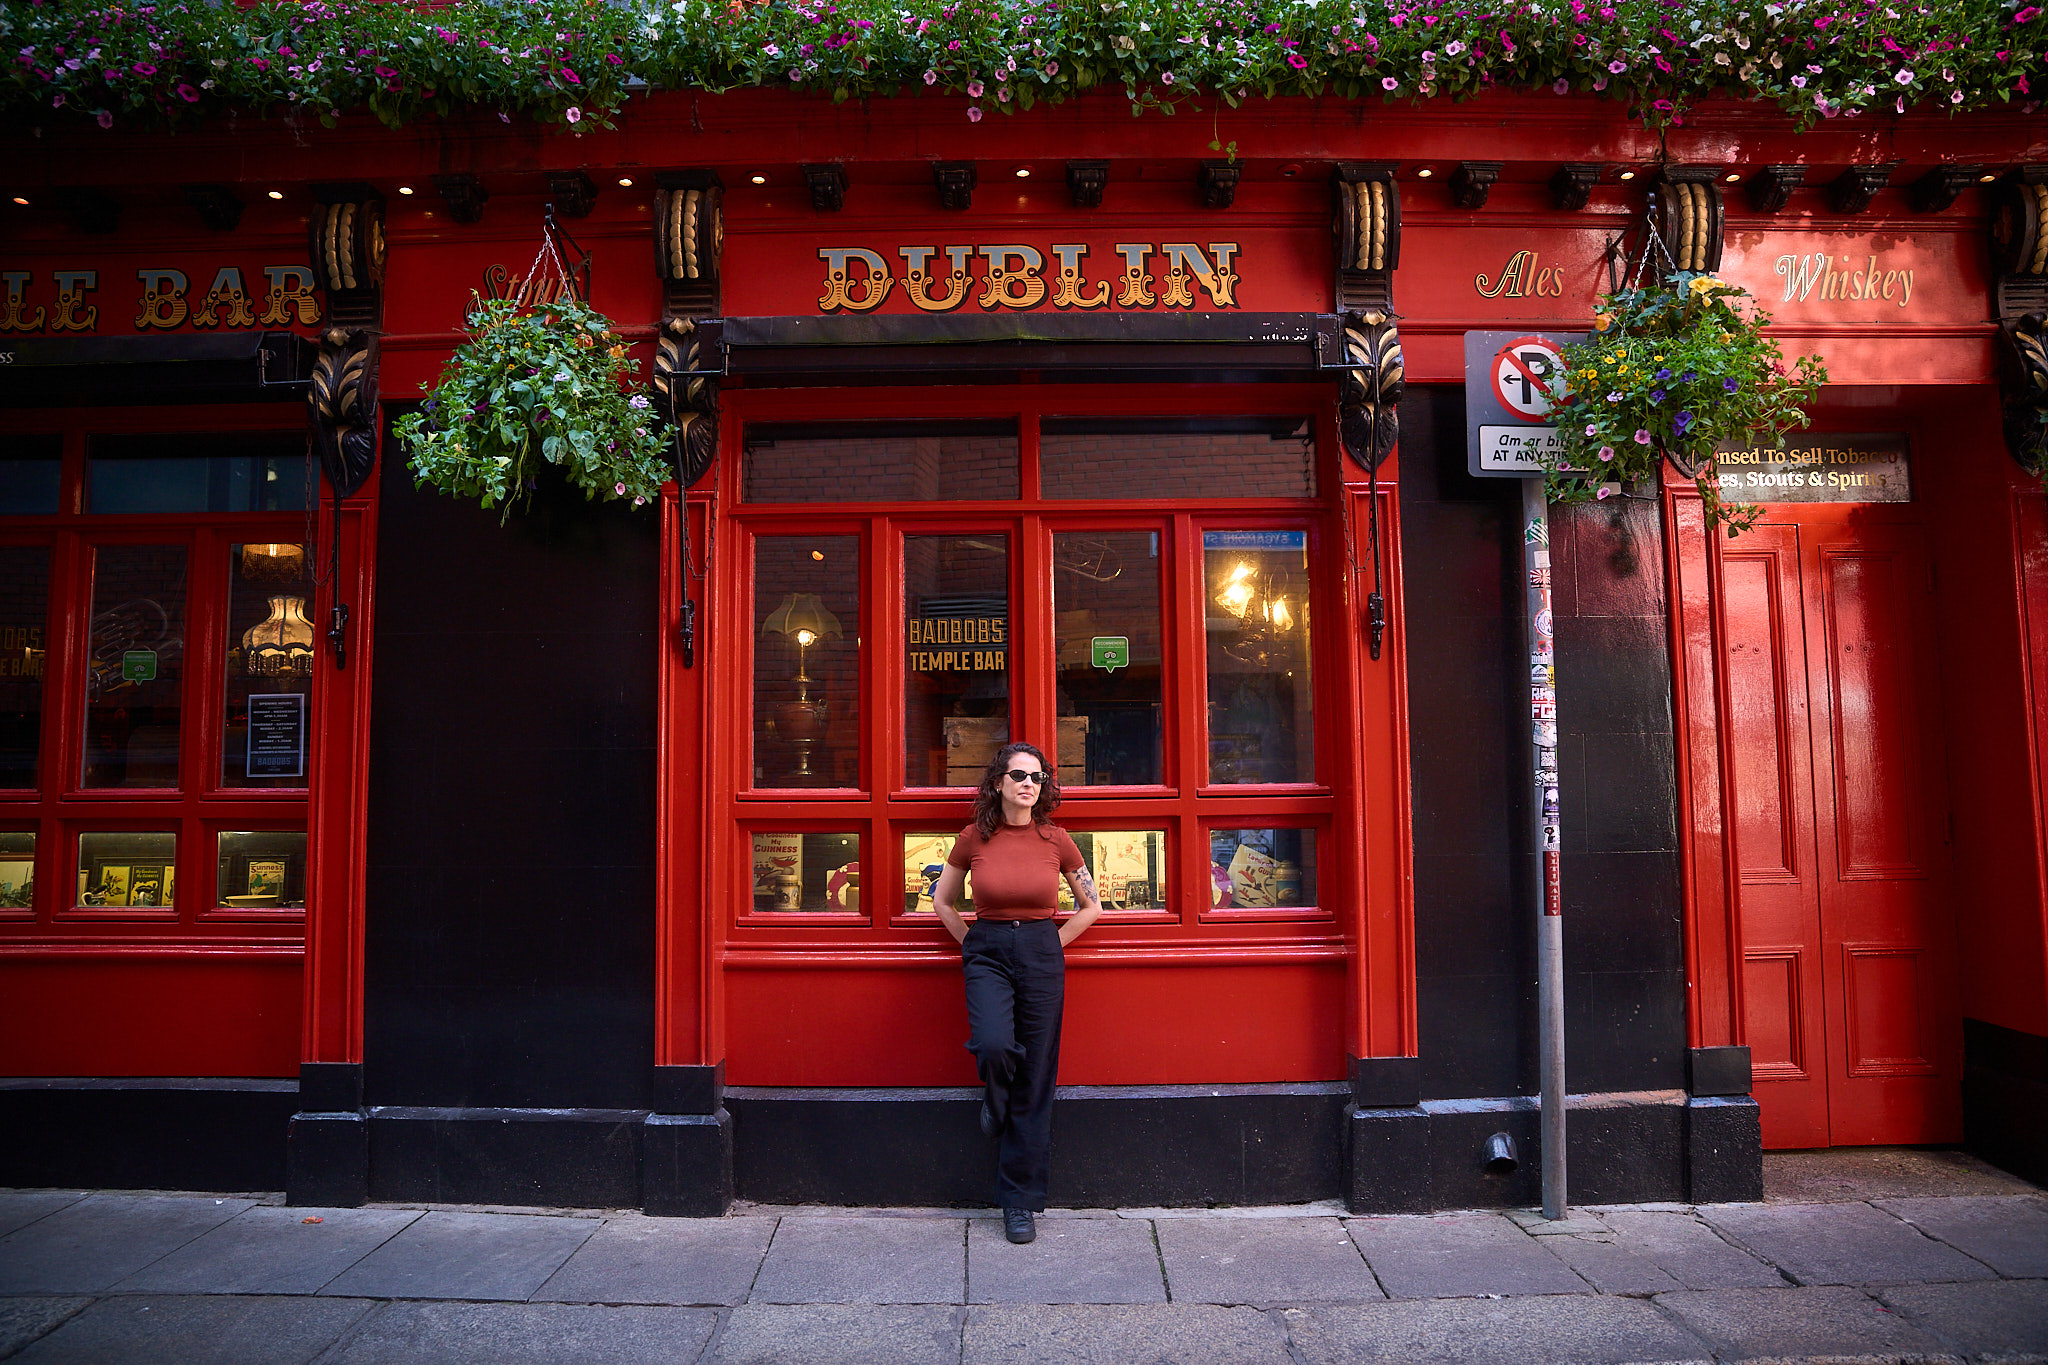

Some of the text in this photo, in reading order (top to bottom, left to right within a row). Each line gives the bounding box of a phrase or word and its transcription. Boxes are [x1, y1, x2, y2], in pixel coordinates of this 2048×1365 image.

[817, 242, 1241, 313] DUBLIN
[1474, 249, 1565, 299] Ales
[1774, 252, 1916, 308] Whiskey
[134, 264, 325, 331] BAR
[1492, 450, 1510, 461] AT
[1515, 450, 1543, 462] ANY
[1764, 447, 1786, 465] To
[1789, 447, 1823, 465] Sell
[1826, 447, 1899, 464] Tobacco
[1745, 471, 1805, 488] Stouts
[1807, 472, 1826, 488] &
[1827, 471, 1887, 492] Spirits
[909, 617, 1004, 644] BADBOBS
[909, 650, 1005, 672] TEMPLE BAR
[753, 844, 798, 853] GUINNESS
[1098, 881, 1109, 890] My
[1099, 873, 1109, 882] My
